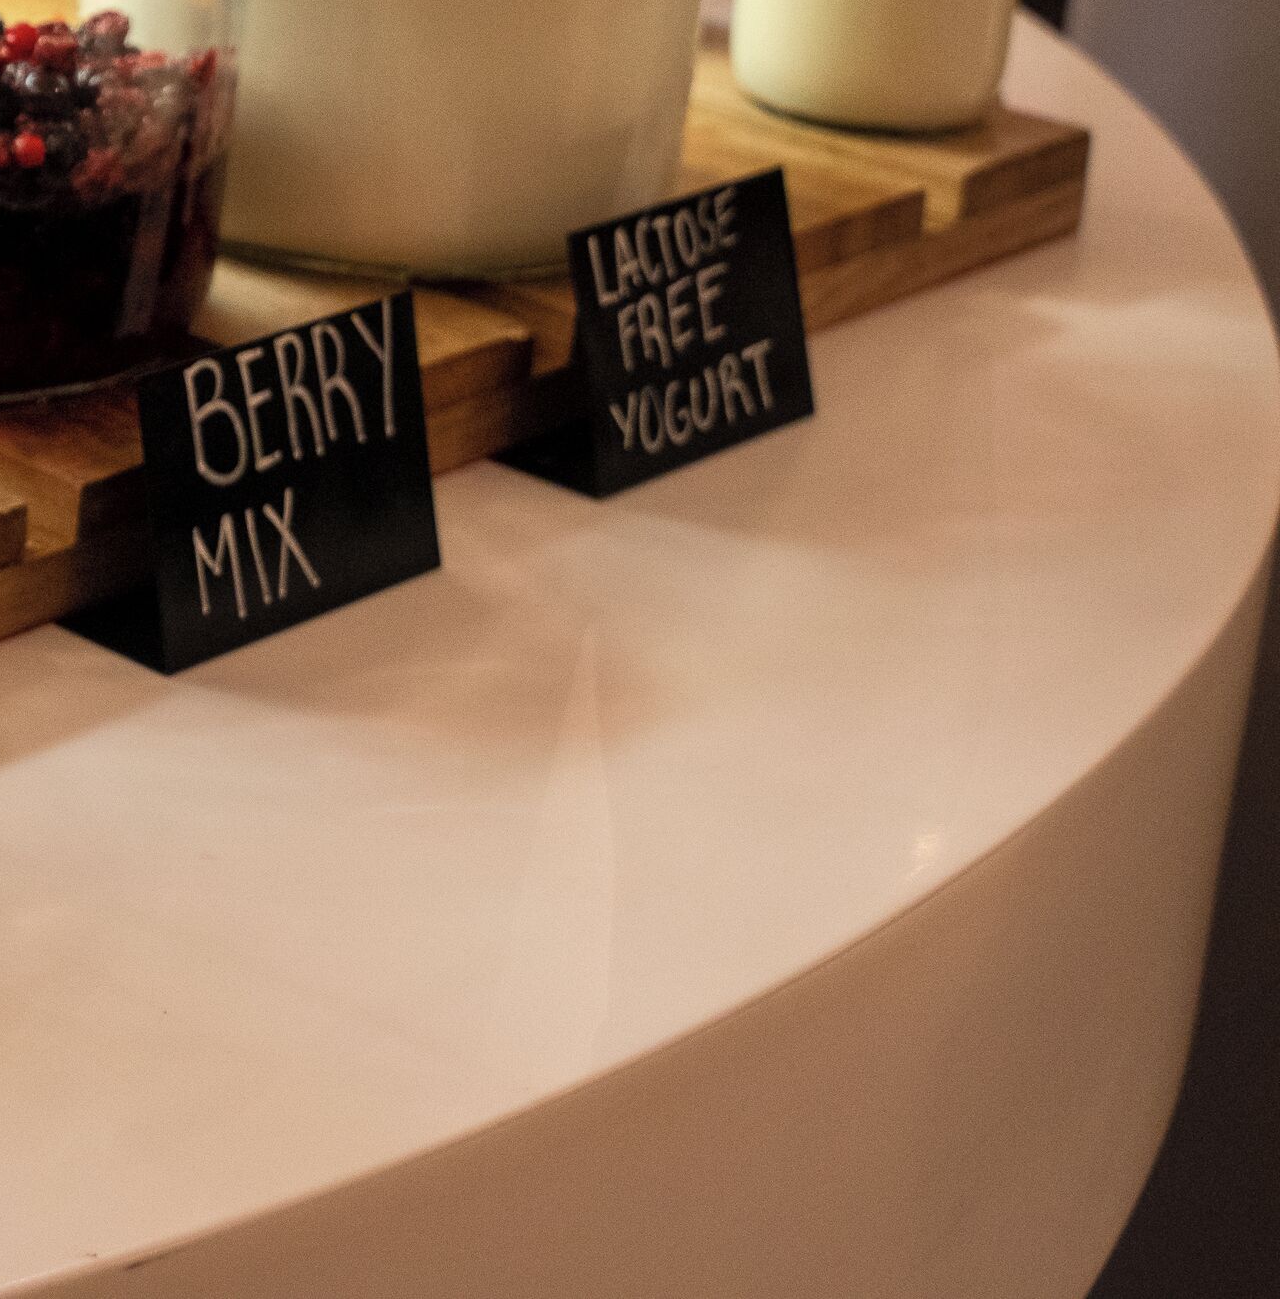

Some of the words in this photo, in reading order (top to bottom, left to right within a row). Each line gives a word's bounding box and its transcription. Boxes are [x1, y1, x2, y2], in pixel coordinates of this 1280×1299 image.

[587, 186, 738, 307] LACTOSE
[617, 262, 730, 372] FREE
[183, 296, 395, 486] BERRY
[609, 338, 775, 453] YOGURT
[192, 487, 322, 620] MIX
